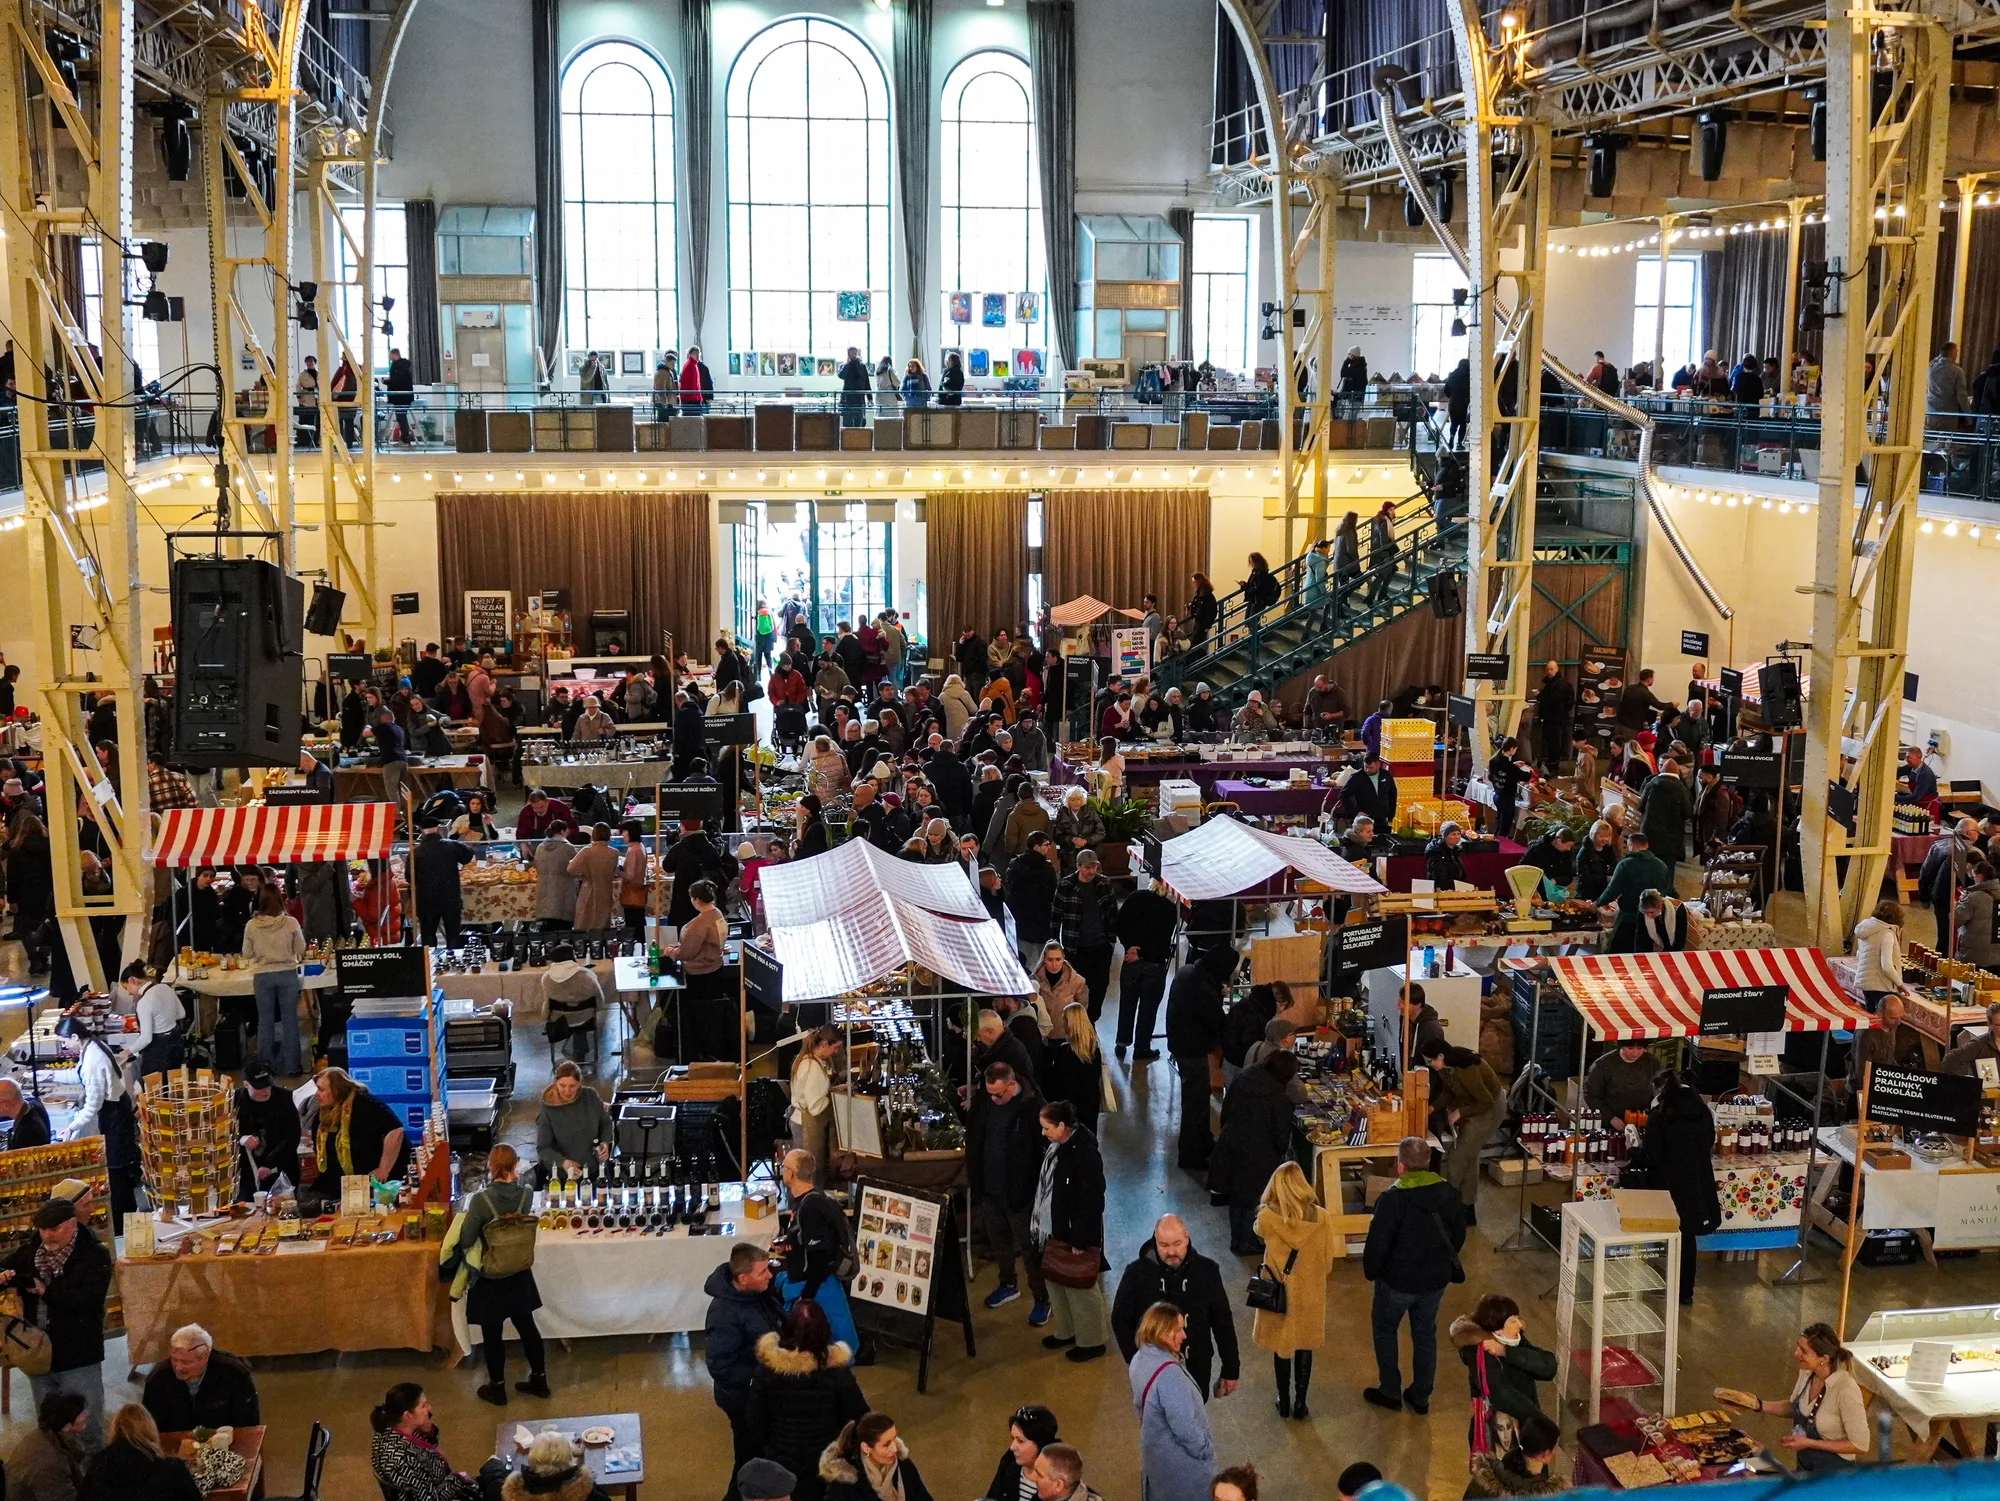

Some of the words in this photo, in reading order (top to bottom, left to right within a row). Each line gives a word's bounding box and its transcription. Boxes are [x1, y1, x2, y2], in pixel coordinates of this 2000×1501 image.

[1342, 925, 1383, 938] PORTUGALSKÉ
[1348, 932, 1382, 943] ŠPANIELSKE
[1342, 939, 1375, 951] DELIKATESY
[341, 953, 382, 961] KORENINY,
[382, 952, 402, 960] SOLI,
[342, 960, 374, 968] OMÁČKY
[1708, 990, 1743, 1000] PRÍRODNÉ
[1743, 990, 1764, 998] ŠŤAVY
[1875, 1068, 1938, 1085] ČOKOLÁDOVÉ
[1874, 1077, 1923, 1092] PRALINKY,
[1873, 1085, 1924, 1099] ČOKOLÁDA
[1871, 1109, 1899, 1118] BRATISLAVA
[1886, 1106, 1904, 1114] POWER
[1924, 1112, 1944, 1120] GLUTEN
